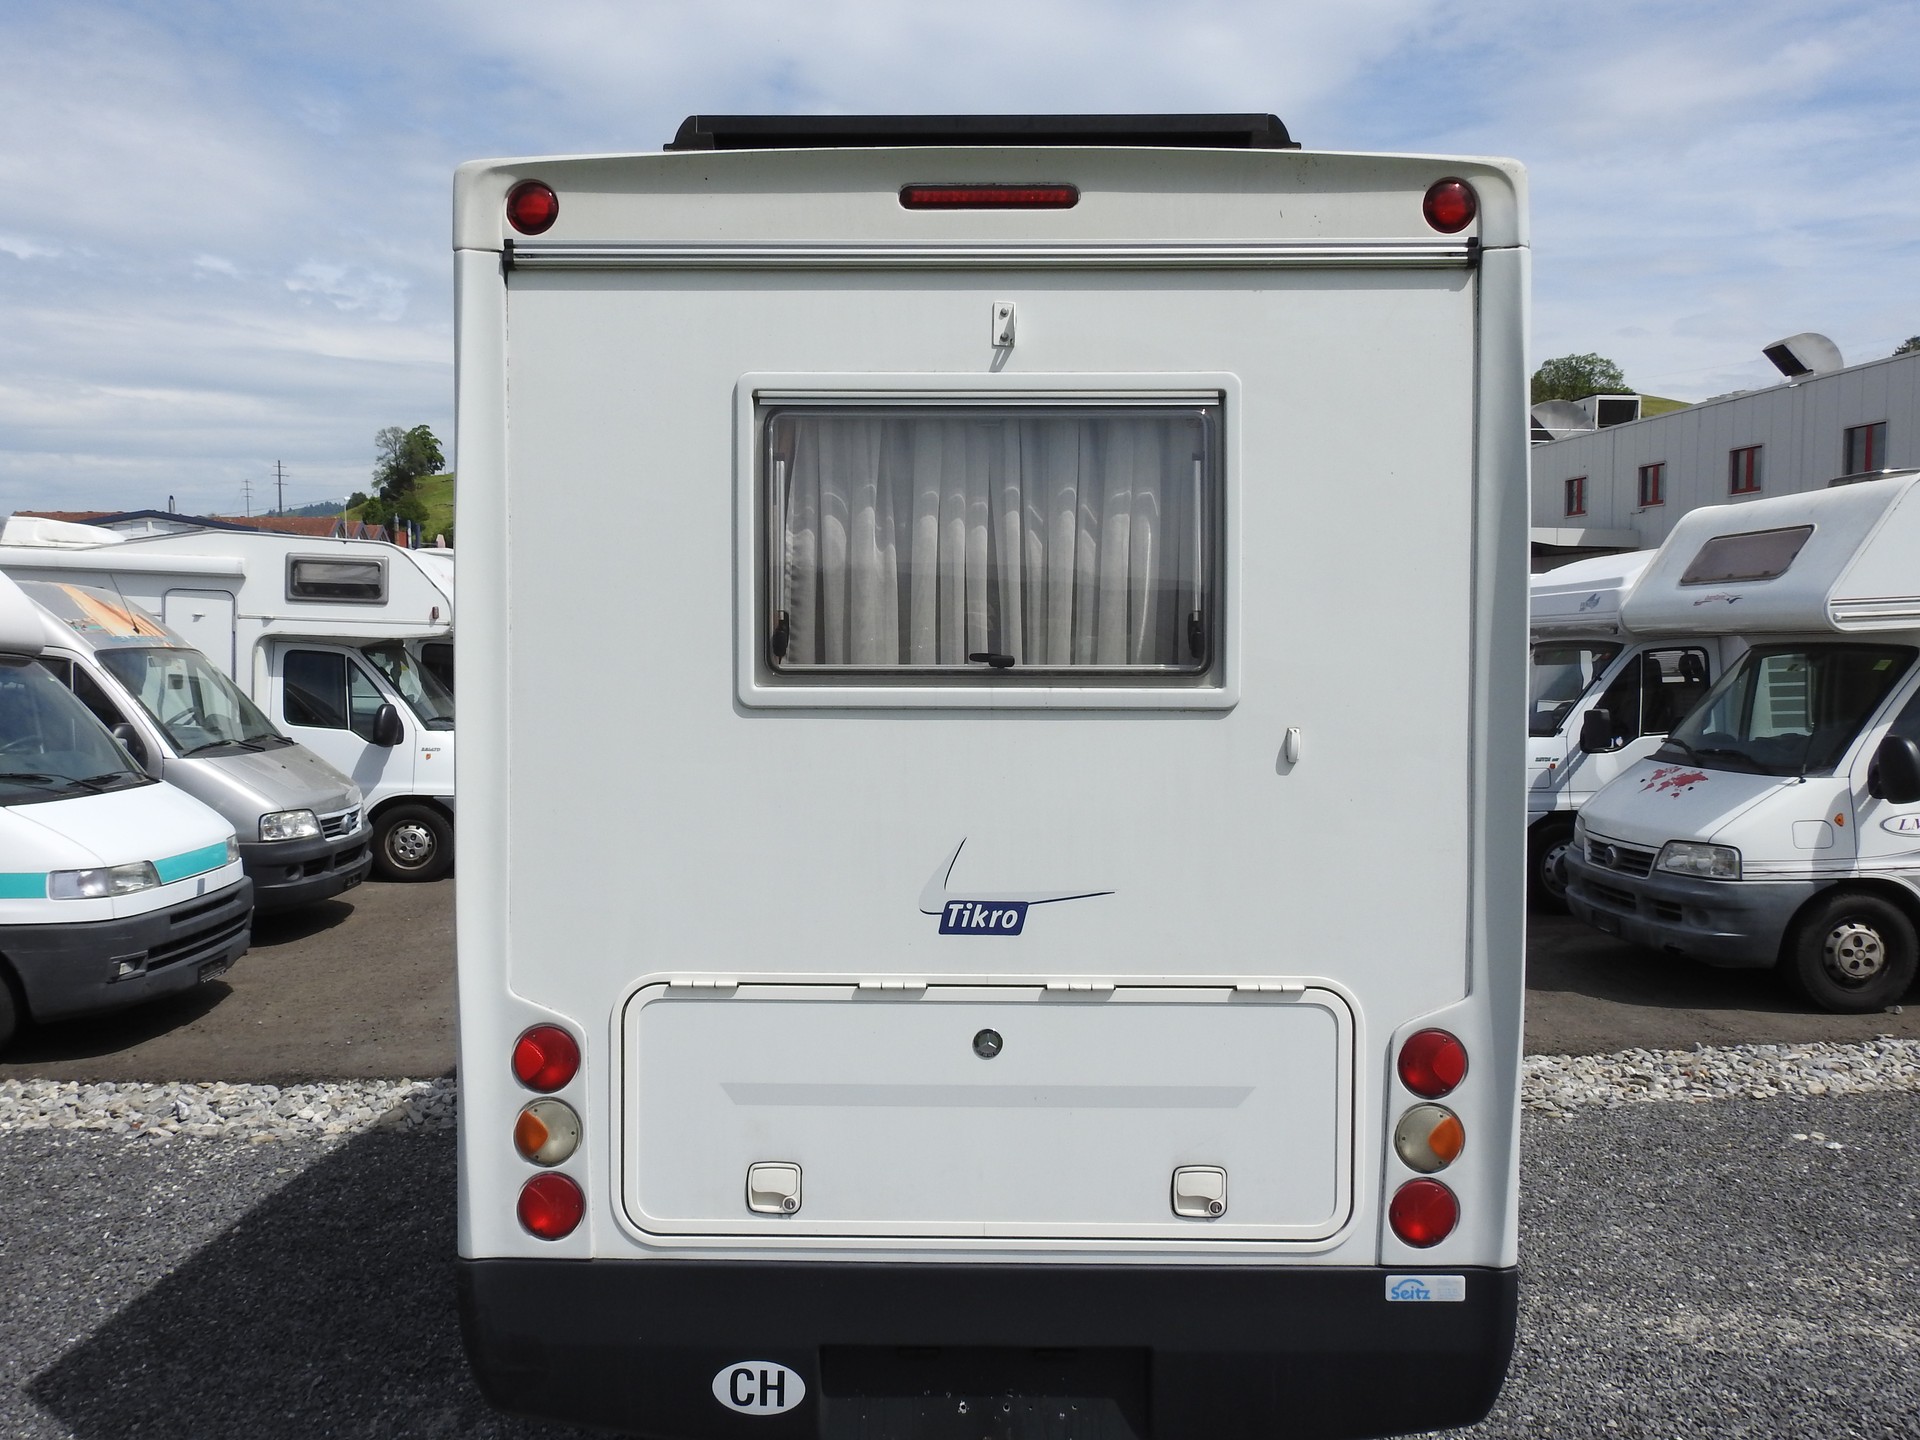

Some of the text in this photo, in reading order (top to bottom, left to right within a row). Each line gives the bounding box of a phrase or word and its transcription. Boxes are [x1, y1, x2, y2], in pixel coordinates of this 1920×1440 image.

[948, 903, 1018, 929] Tikro
[1391, 1285, 1431, 1300] Seitz
[729, 1368, 785, 1407] CH
